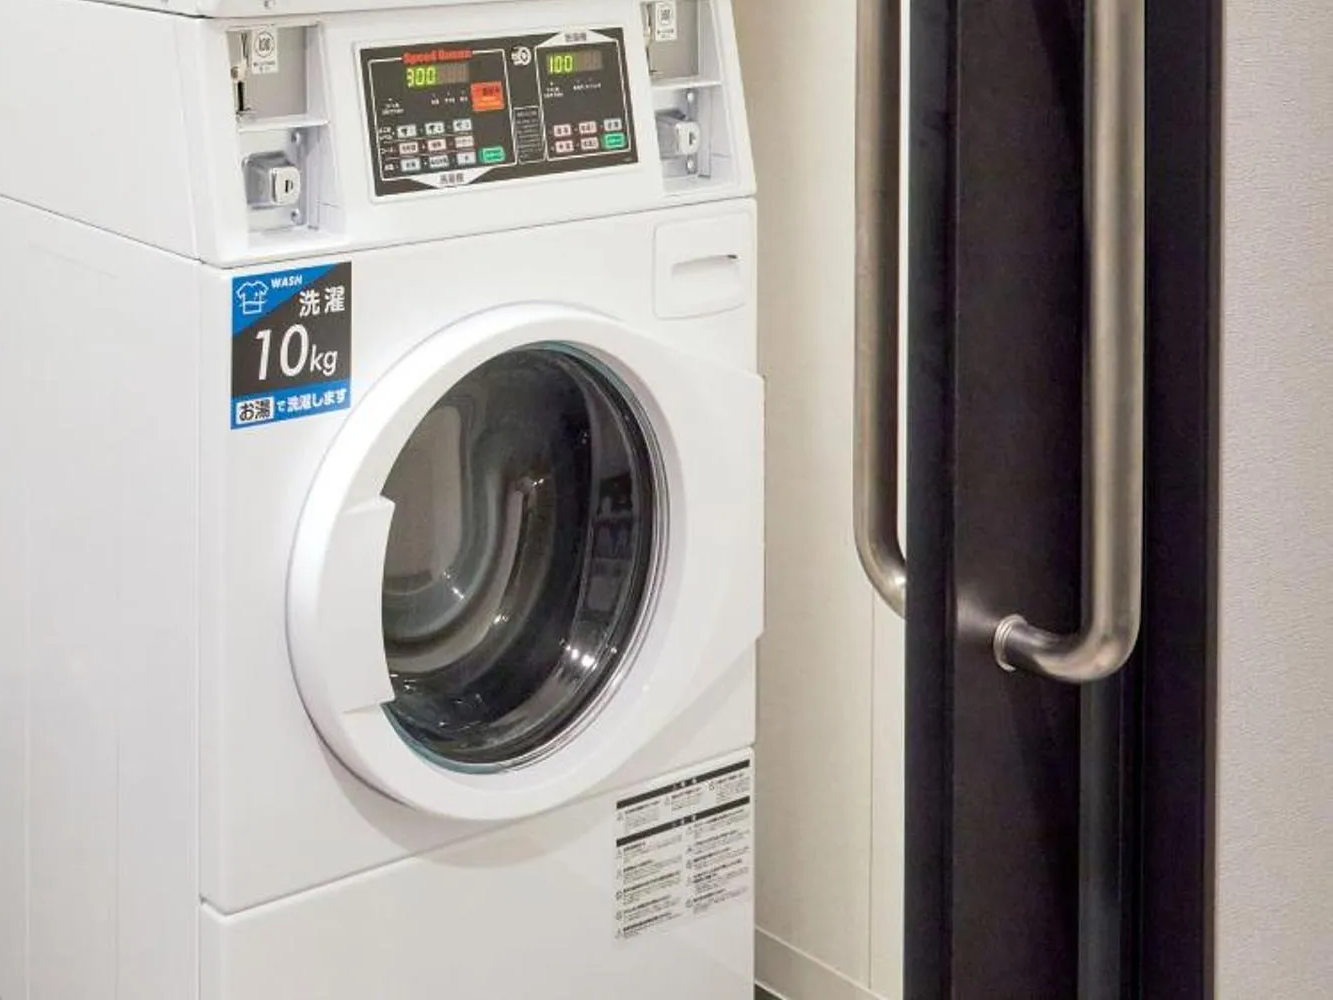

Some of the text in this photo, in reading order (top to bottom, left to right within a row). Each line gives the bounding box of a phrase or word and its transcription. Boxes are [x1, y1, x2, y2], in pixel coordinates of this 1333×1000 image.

[407, 66, 436, 88] 300
[270, 274, 303, 289] WASH
[298, 285, 346, 318] 洗濯
[256, 323, 339, 381] 10kg
